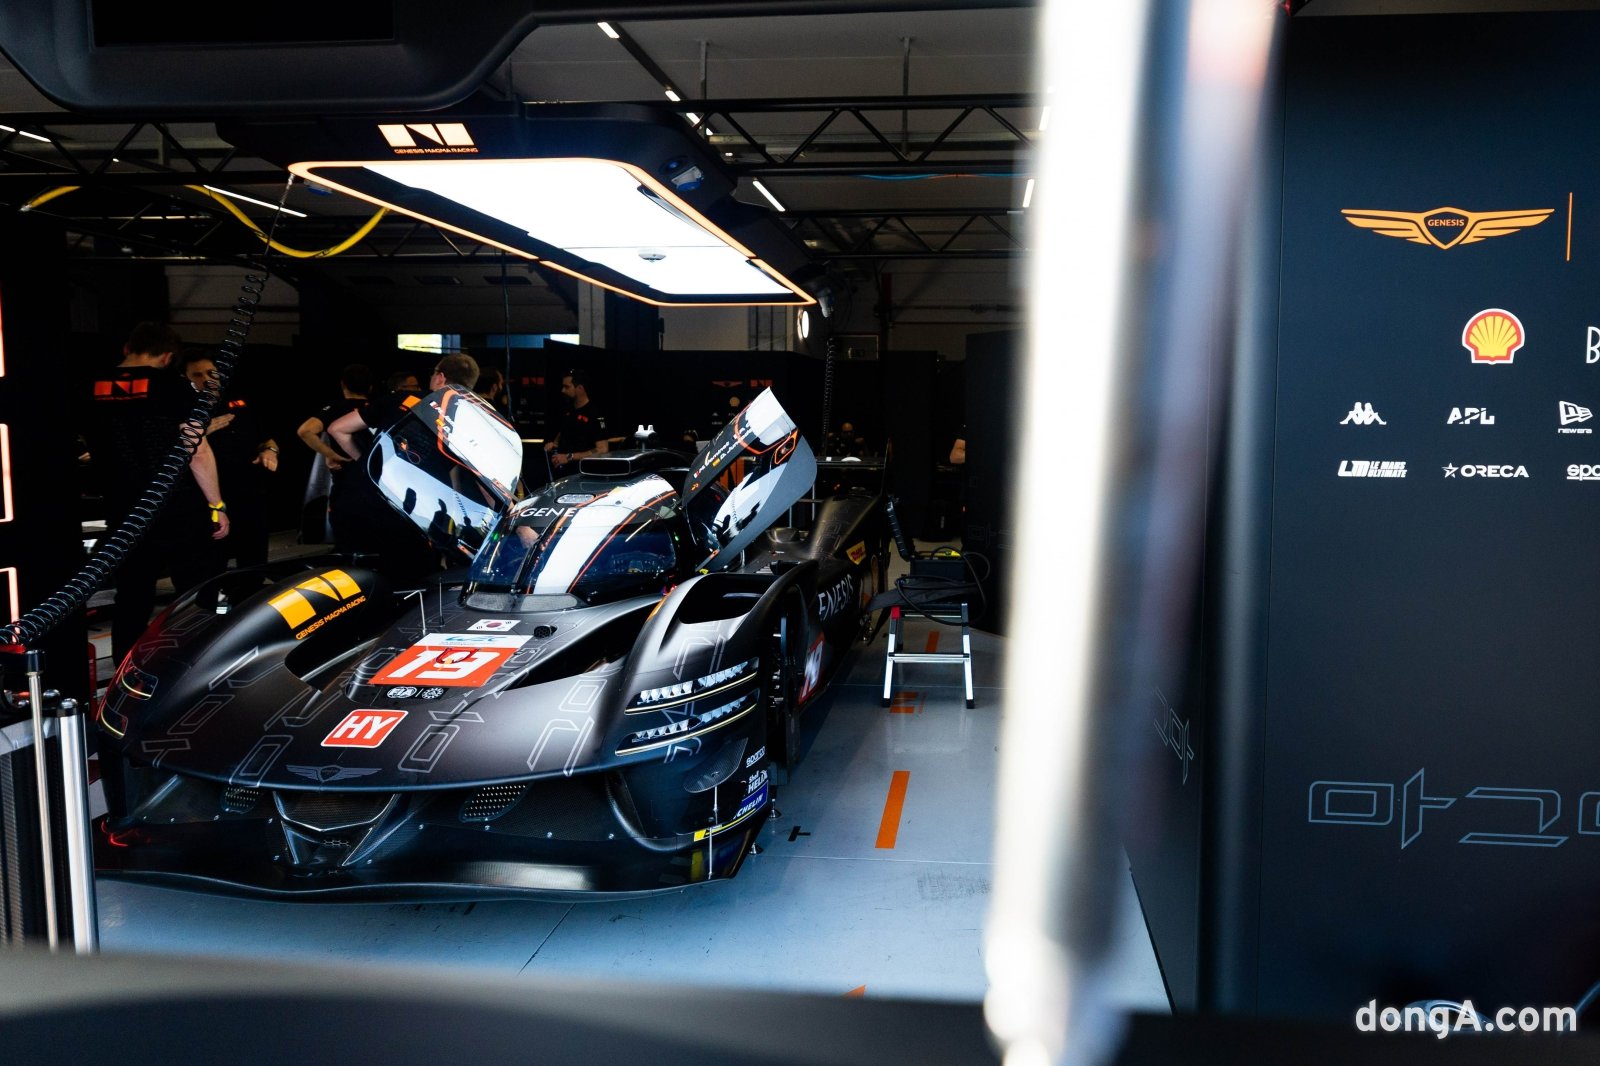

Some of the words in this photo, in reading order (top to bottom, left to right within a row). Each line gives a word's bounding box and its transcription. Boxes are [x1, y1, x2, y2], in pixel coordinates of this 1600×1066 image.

[1427, 218, 1465, 227] GENESIS
[1447, 407, 1495, 425] APL
[1367, 469, 1408, 478] ULTIMATE
[1460, 464, 1530, 478] ORECA
[520, 507, 577, 518] GENE
[295, 618, 325, 640] GENESIS
[324, 605, 348, 623] MAGMA
[346, 595, 367, 610] RACING
[386, 650, 501, 680] 19
[332, 715, 399, 740] HY
